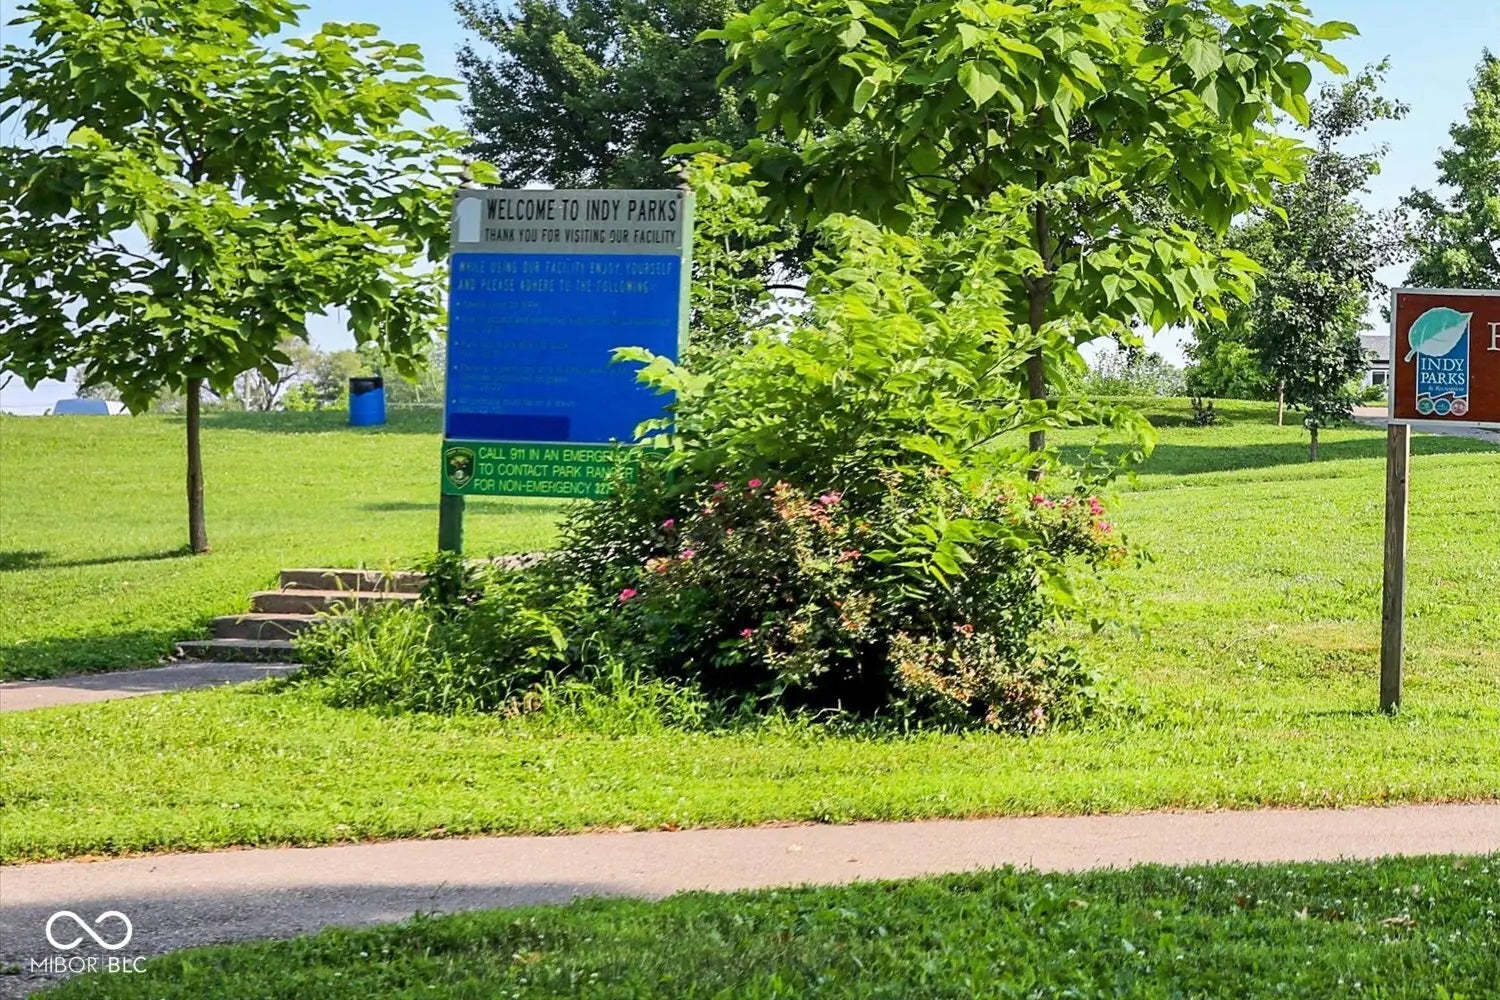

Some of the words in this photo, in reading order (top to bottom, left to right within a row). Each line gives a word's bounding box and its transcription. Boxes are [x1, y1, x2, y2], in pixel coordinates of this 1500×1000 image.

[487, 199, 555, 221] WELCOME
[562, 199, 579, 221] TO
[586, 199, 620, 221] INDY
[627, 199, 677, 222] PARKS
[485, 228, 515, 242] THANK
[519, 228, 538, 243] YOU
[541, 228, 560, 243] FOR
[565, 229, 605, 243] VISITING
[610, 229, 629, 243] OUR
[634, 229, 676, 244] FACILITY
[1421, 357, 1465, 372] INDY
[1420, 372, 1466, 386] PARKS
[478, 447, 506, 460] CALL
[510, 447, 526, 460] 911
[529, 448, 540, 461] IN
[543, 448, 559, 461] AN
[478, 463, 494, 476] TO
[497, 463, 548, 477] CONTACT
[552, 465, 582, 478] PARK
[473, 478, 496, 491] FOR
[499, 480, 593, 494] NON-EMERGENCY
